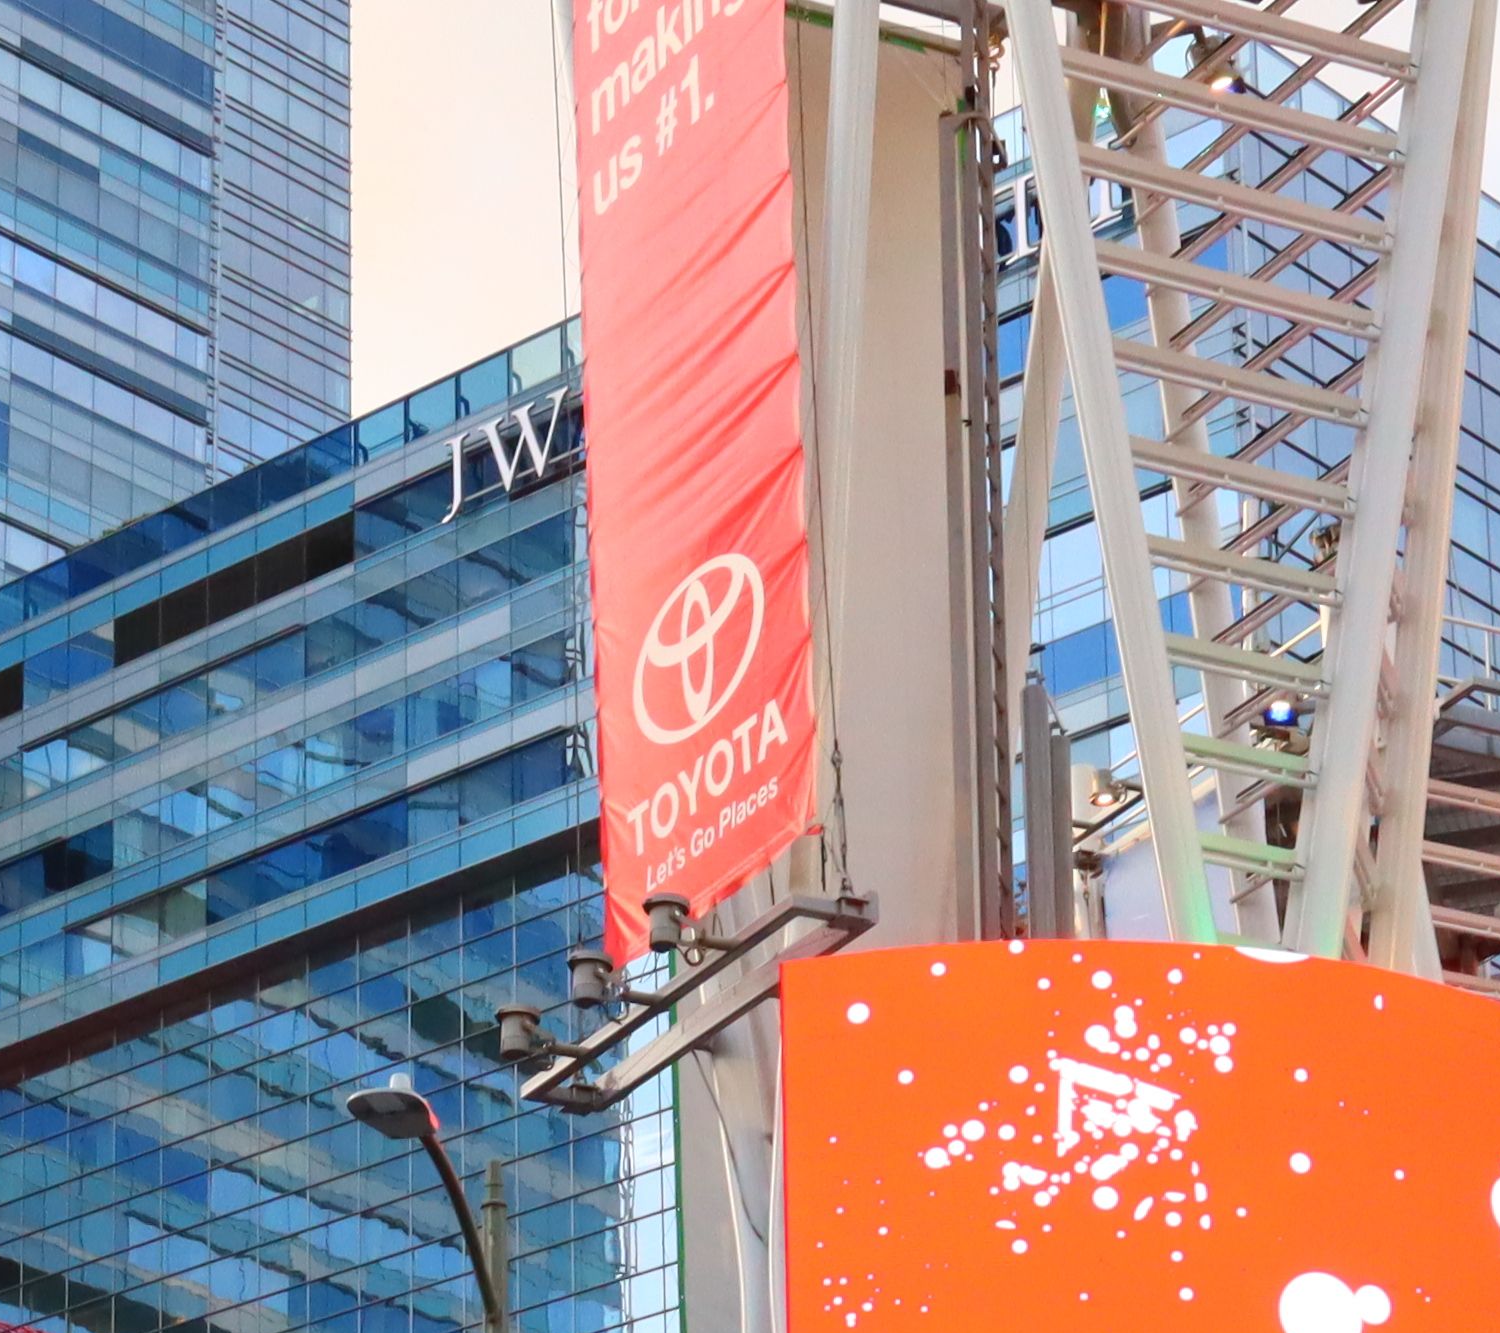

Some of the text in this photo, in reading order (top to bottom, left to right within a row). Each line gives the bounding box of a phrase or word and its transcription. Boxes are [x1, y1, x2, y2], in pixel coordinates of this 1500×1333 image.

[587, 0, 640, 54] fo
[593, 54, 715, 215] us #1.
[442, 386, 569, 524] JW
[627, 699, 789, 857] TOYOTA
[646, 776, 778, 893] Let's Go Places
